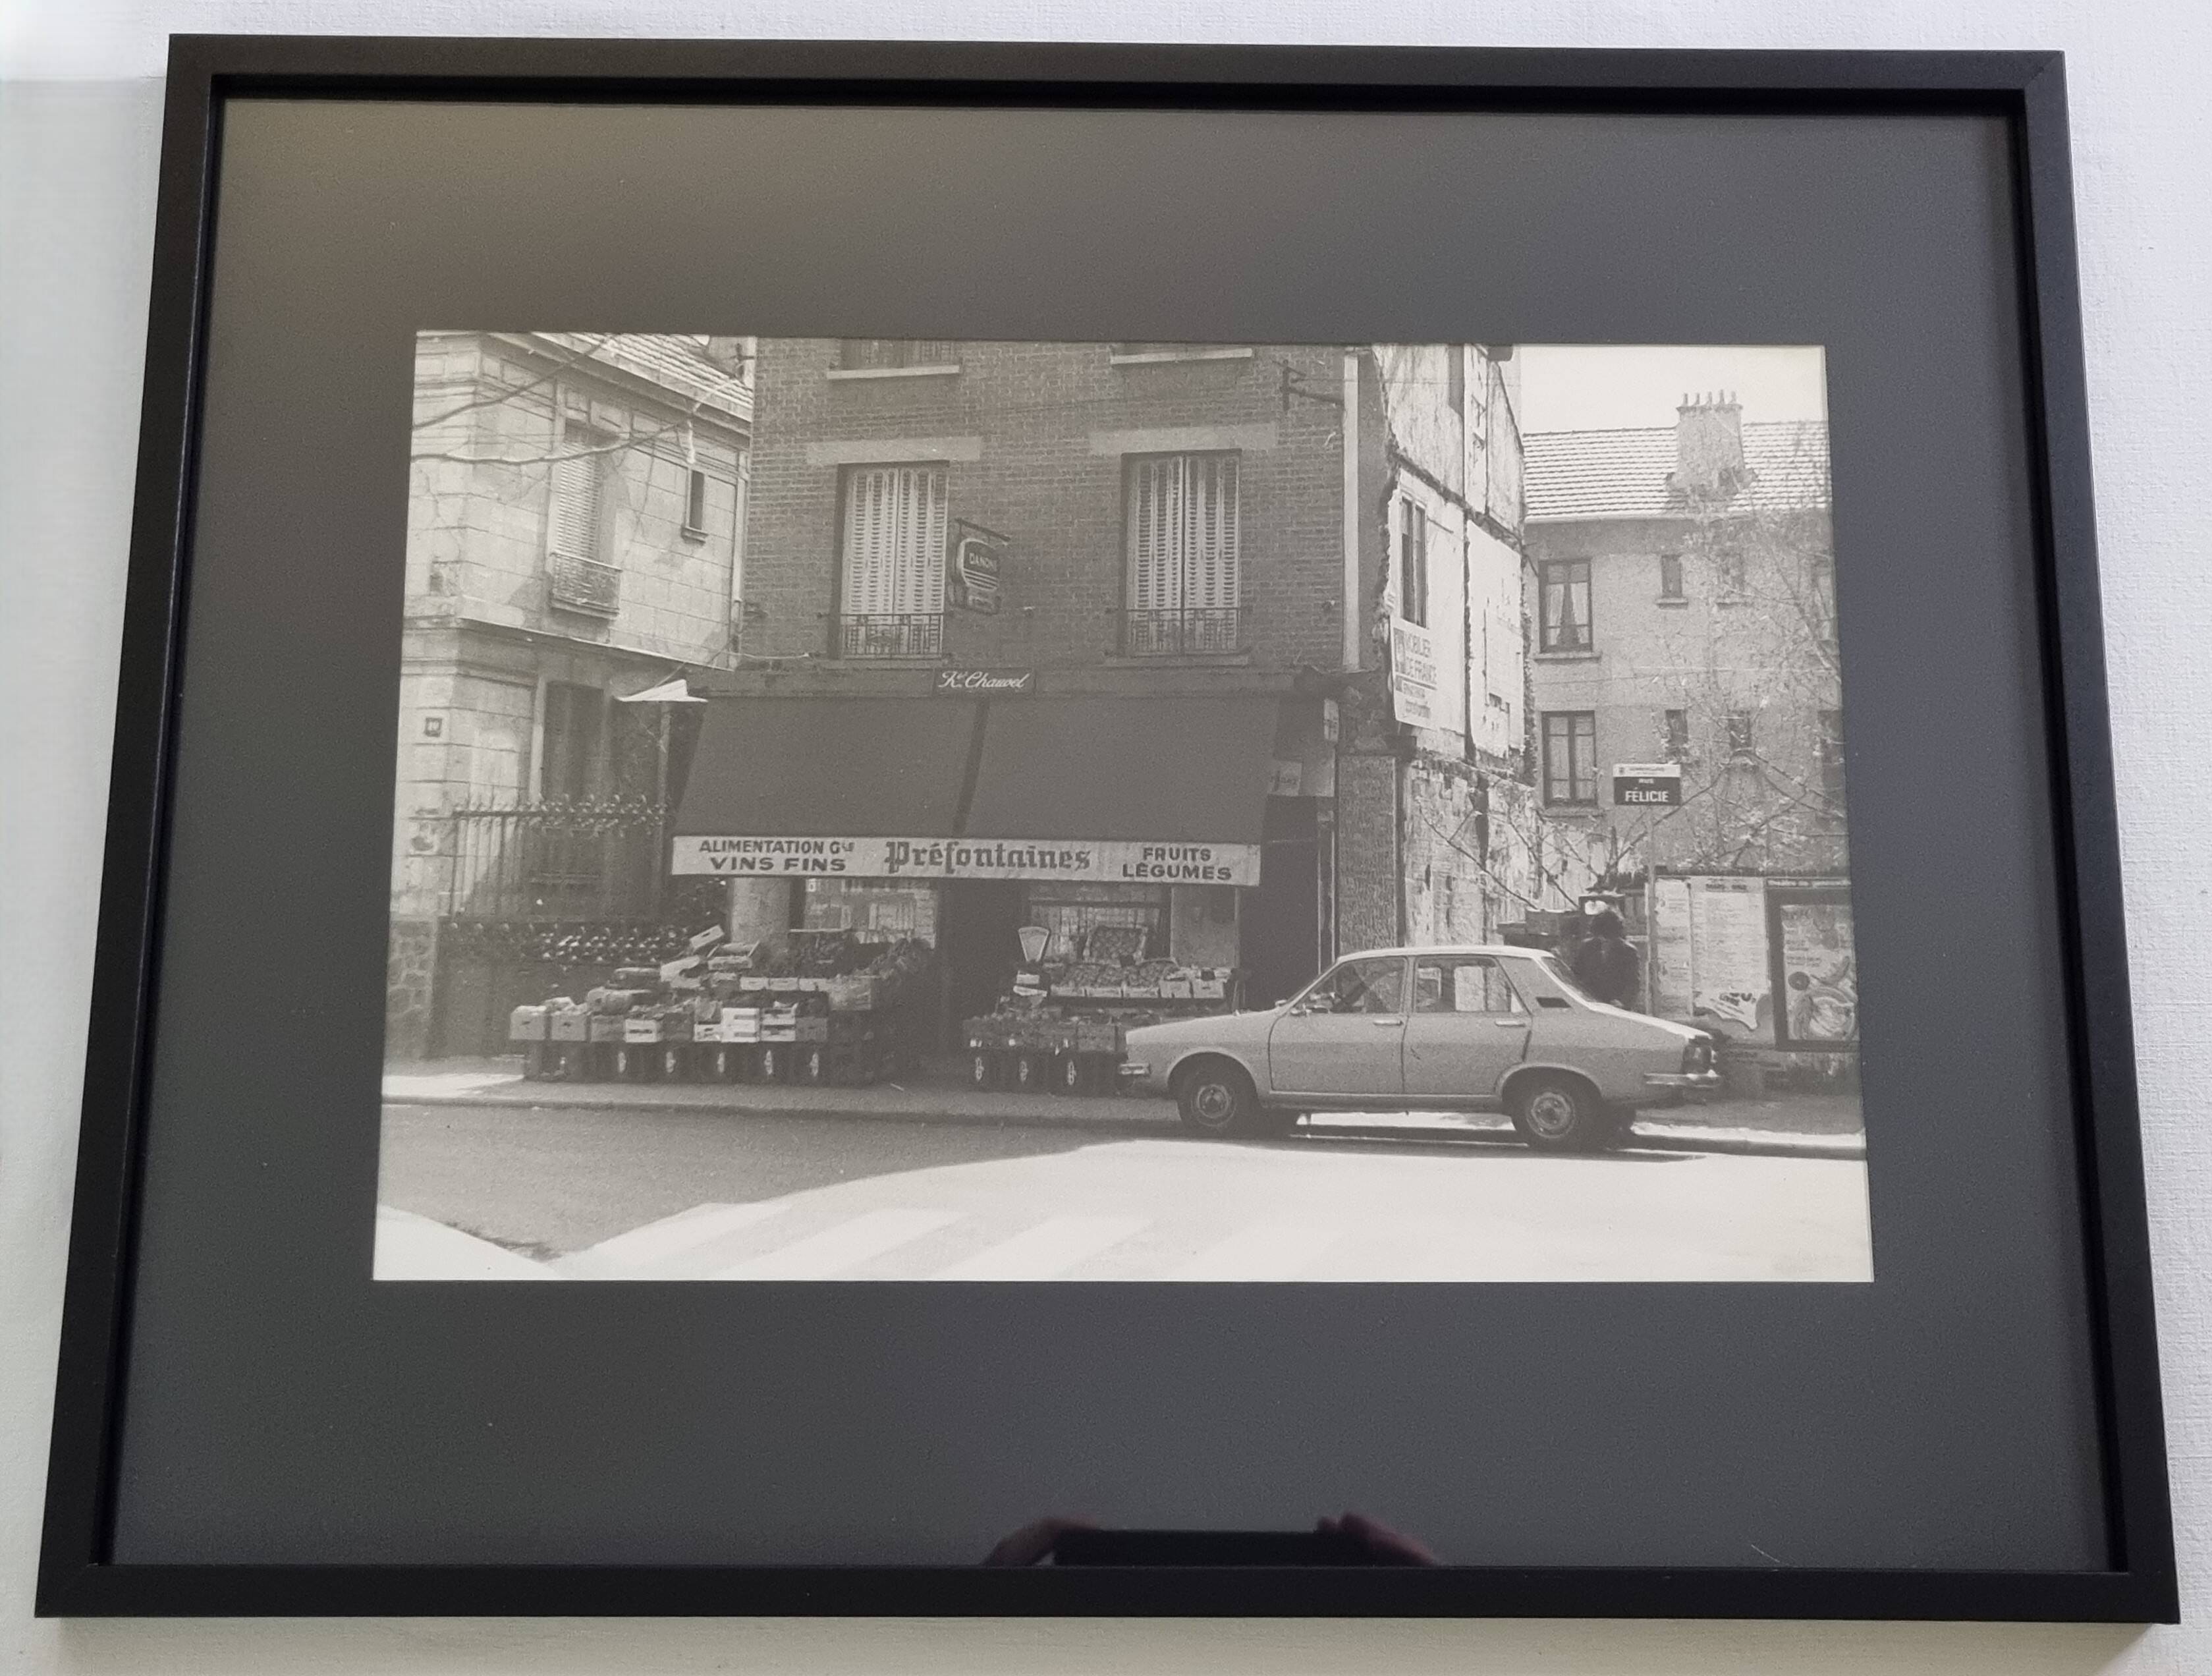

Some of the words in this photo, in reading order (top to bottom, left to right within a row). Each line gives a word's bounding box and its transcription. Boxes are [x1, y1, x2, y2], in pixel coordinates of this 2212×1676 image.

[699, 840, 825, 854] ALIMENTATION
[1142, 847, 1212, 862] FRUITS
[710, 856, 775, 871] VINS
[783, 857, 846, 872] FINS
[884, 841, 1091, 874] Préfontaines
